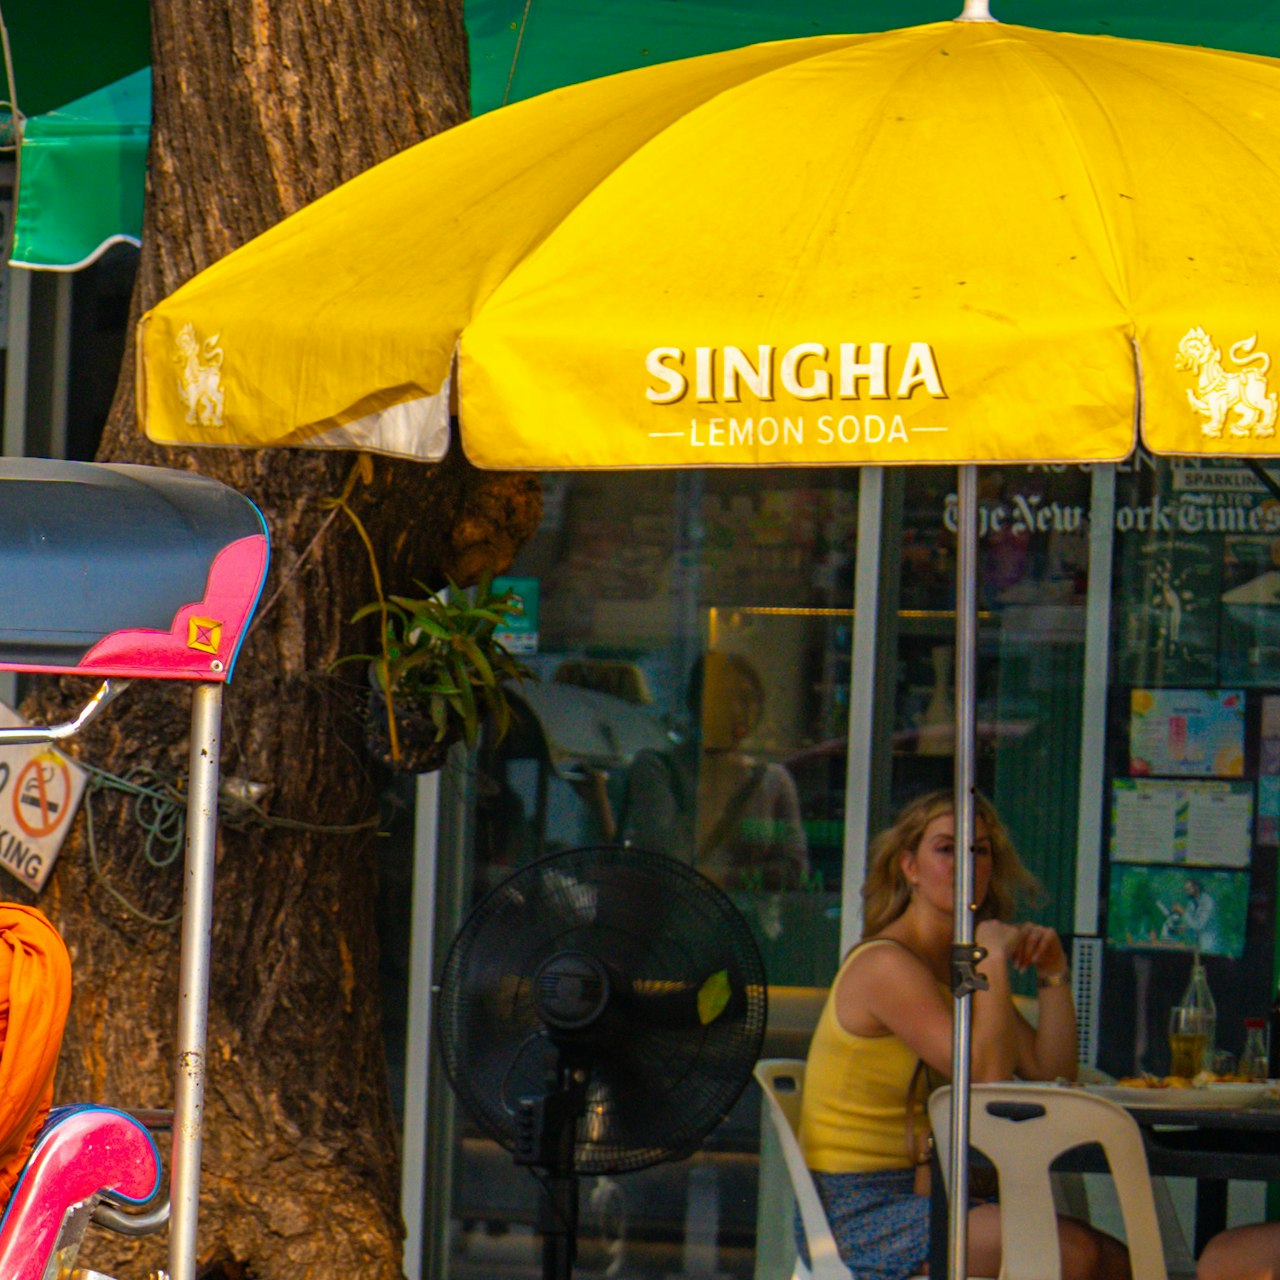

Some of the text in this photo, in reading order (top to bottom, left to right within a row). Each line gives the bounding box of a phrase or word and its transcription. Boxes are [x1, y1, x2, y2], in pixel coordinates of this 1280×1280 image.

[644, 342, 950, 405] SINGHA
[689, 414, 910, 446] LEMON SODA
[1184, 471, 1258, 486] SPARKLIN
[1011, 493, 1084, 537] New
[1100, 496, 1174, 533] ork
[1177, 496, 1280, 534] Times
